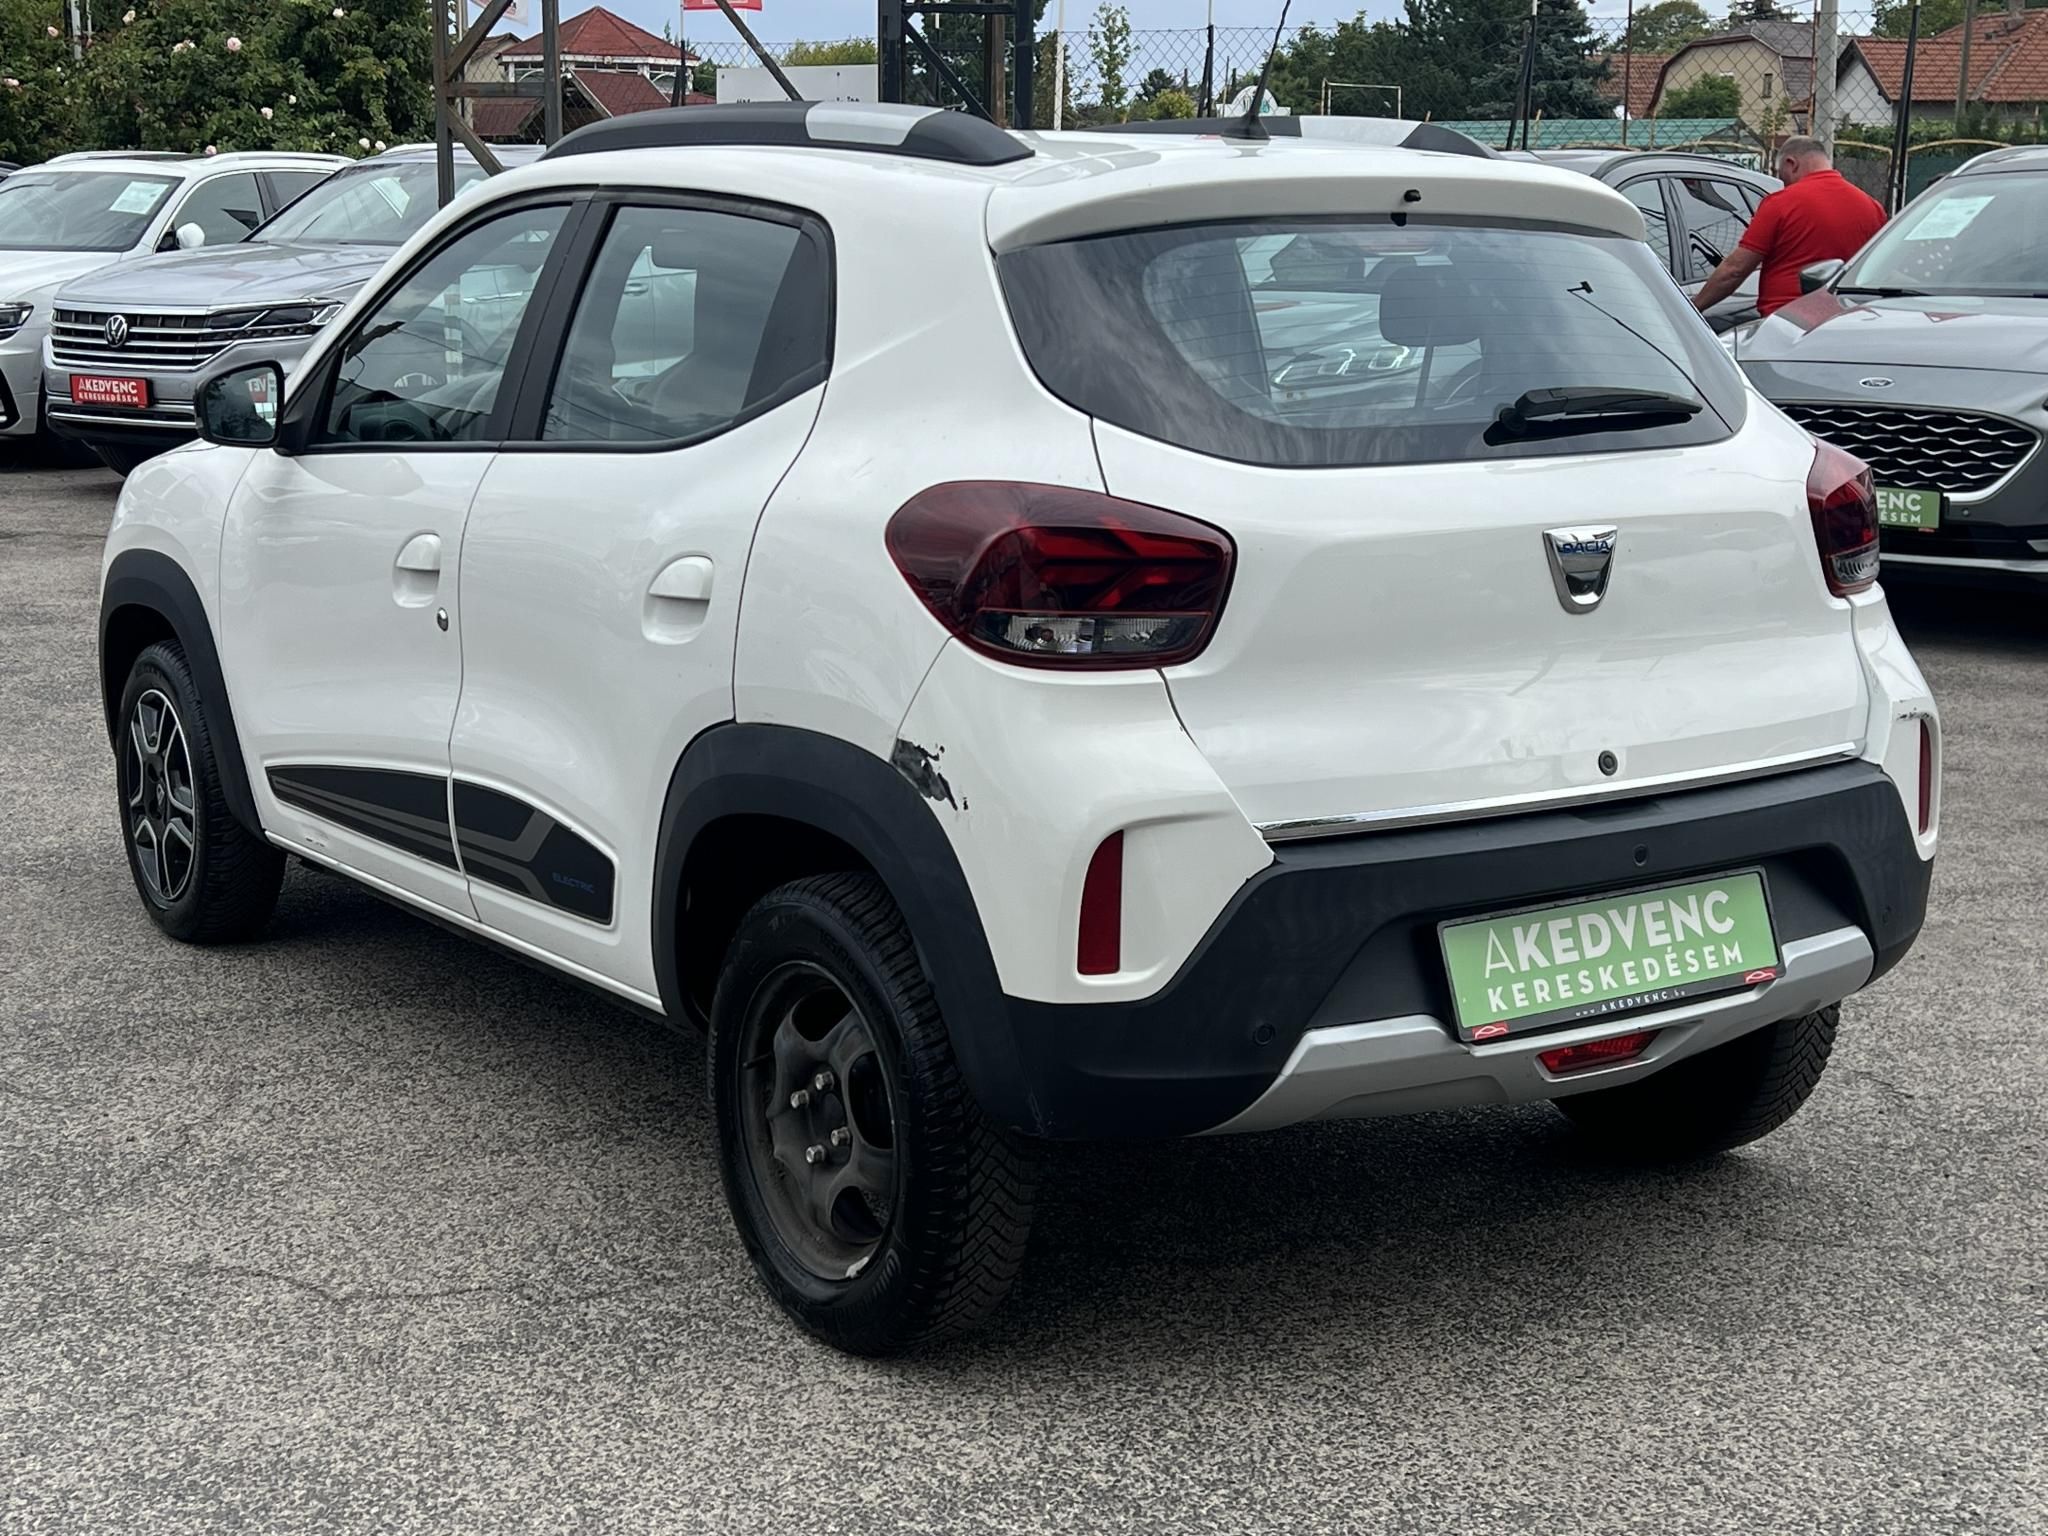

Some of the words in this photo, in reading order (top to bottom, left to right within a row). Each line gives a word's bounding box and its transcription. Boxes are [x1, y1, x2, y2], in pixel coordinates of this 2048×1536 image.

[78, 378, 138, 394] AKEDVENC
[1876, 490, 1922, 511] ENC
[1880, 508, 1921, 524] ÉSEM
[1485, 890, 1735, 978] AKEDVENC
[1487, 940, 1743, 1013] KERESKEDÉSEM
